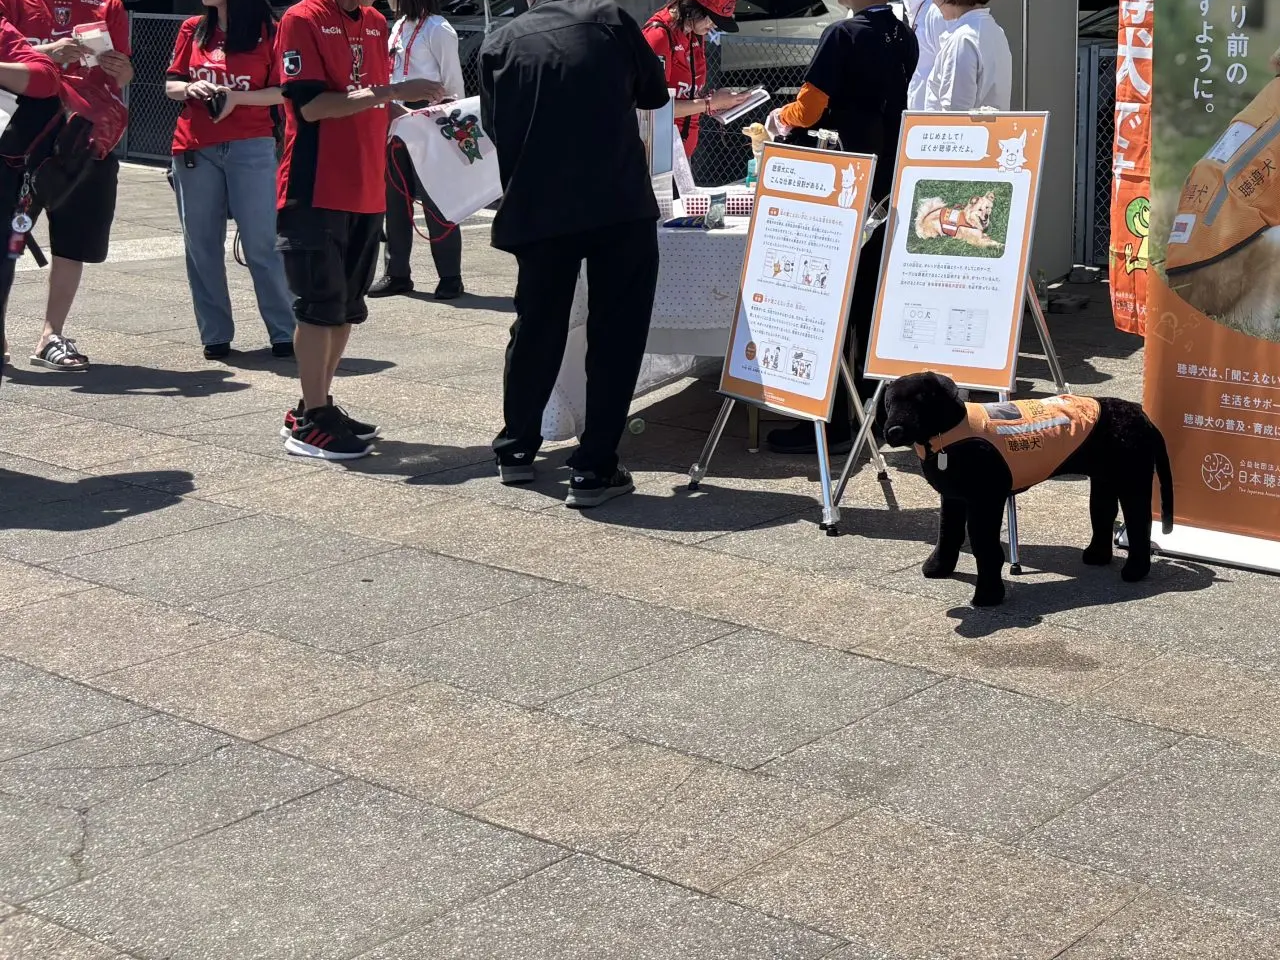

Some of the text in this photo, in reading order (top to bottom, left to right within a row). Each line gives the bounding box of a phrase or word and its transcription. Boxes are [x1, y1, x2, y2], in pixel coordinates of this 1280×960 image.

[1238, 158, 1276, 198] 聴導犬
[1008, 437, 1042, 452] 聴導犬
